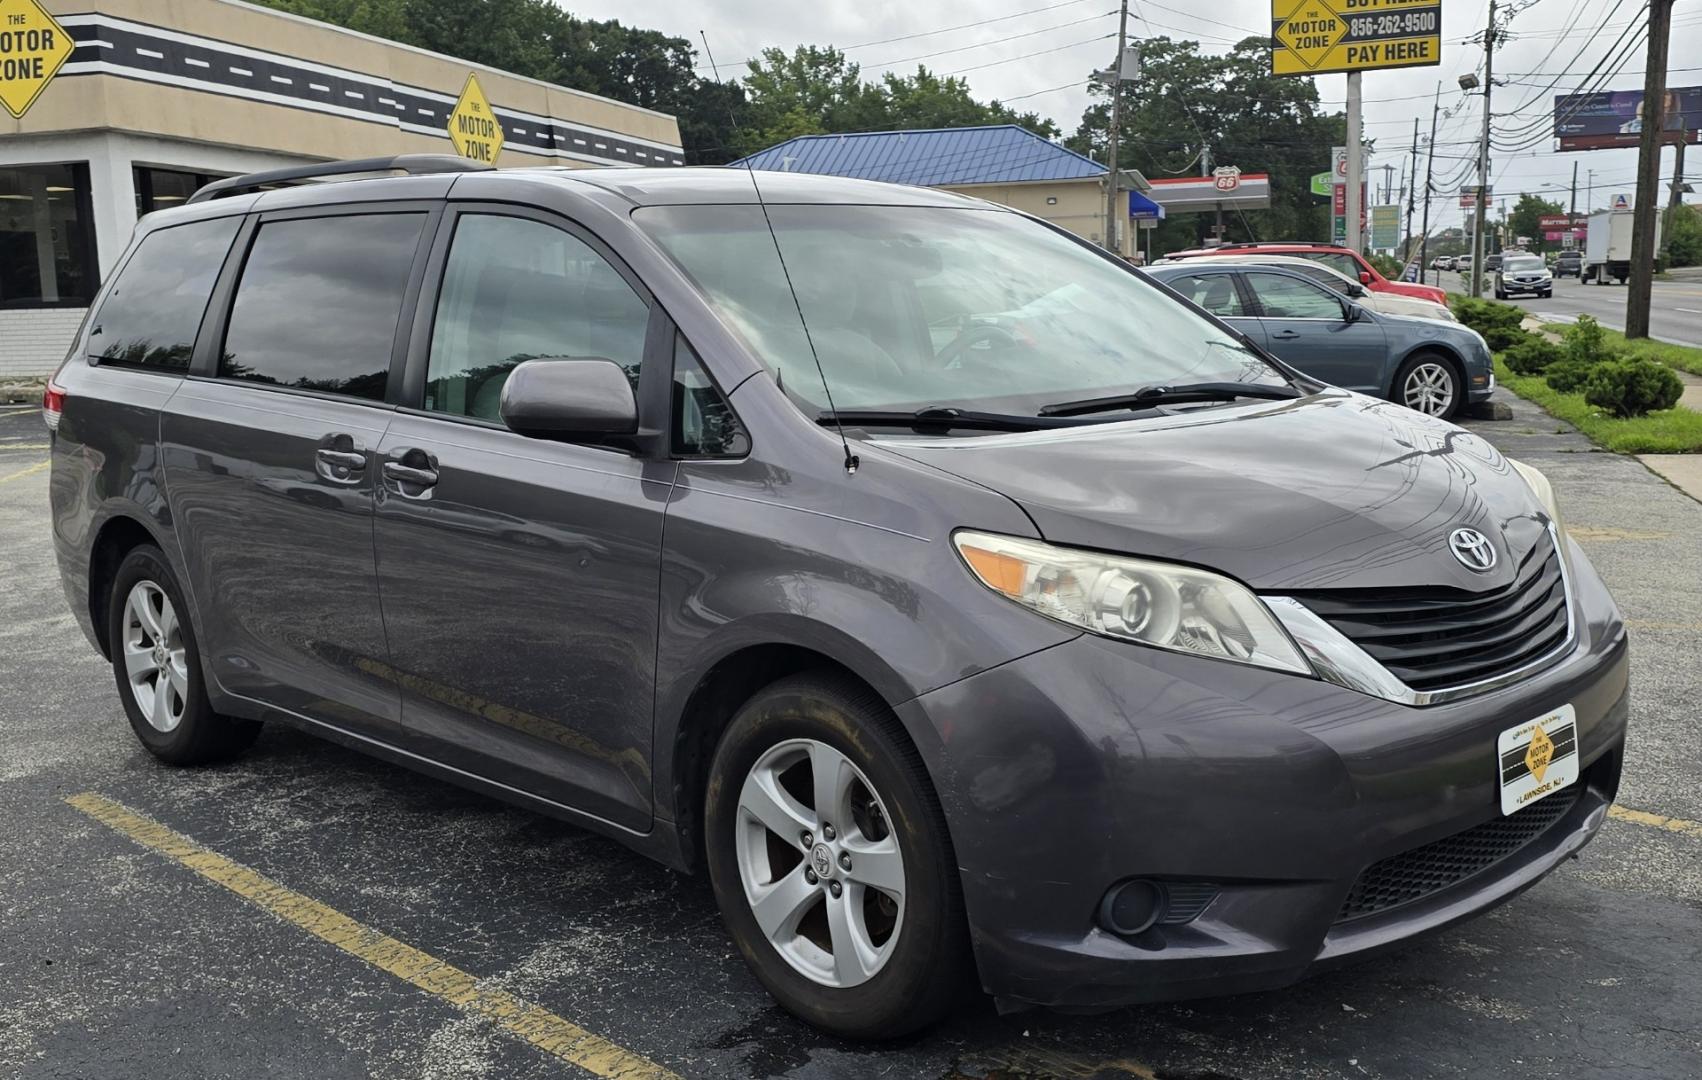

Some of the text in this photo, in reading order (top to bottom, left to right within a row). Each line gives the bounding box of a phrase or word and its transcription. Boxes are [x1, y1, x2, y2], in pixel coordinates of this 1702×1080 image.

[8, 14, 26, 25] THE
[1288, 19, 1336, 35] MOTOR
[1351, 12, 1435, 37] 856-262-9500
[0, 29, 54, 53] OTOR
[1295, 35, 1329, 49] ZONE
[1347, 41, 1429, 63] PAY HERE
[0, 57, 43, 81] ONE
[470, 102, 480, 112] THE
[458, 114, 495, 139] MOTOR
[465, 140, 491, 162] ZONE
[1218, 177, 1235, 188] 66
[1530, 742, 1549, 759] MOTOR
[1533, 755, 1547, 770] ZONE
